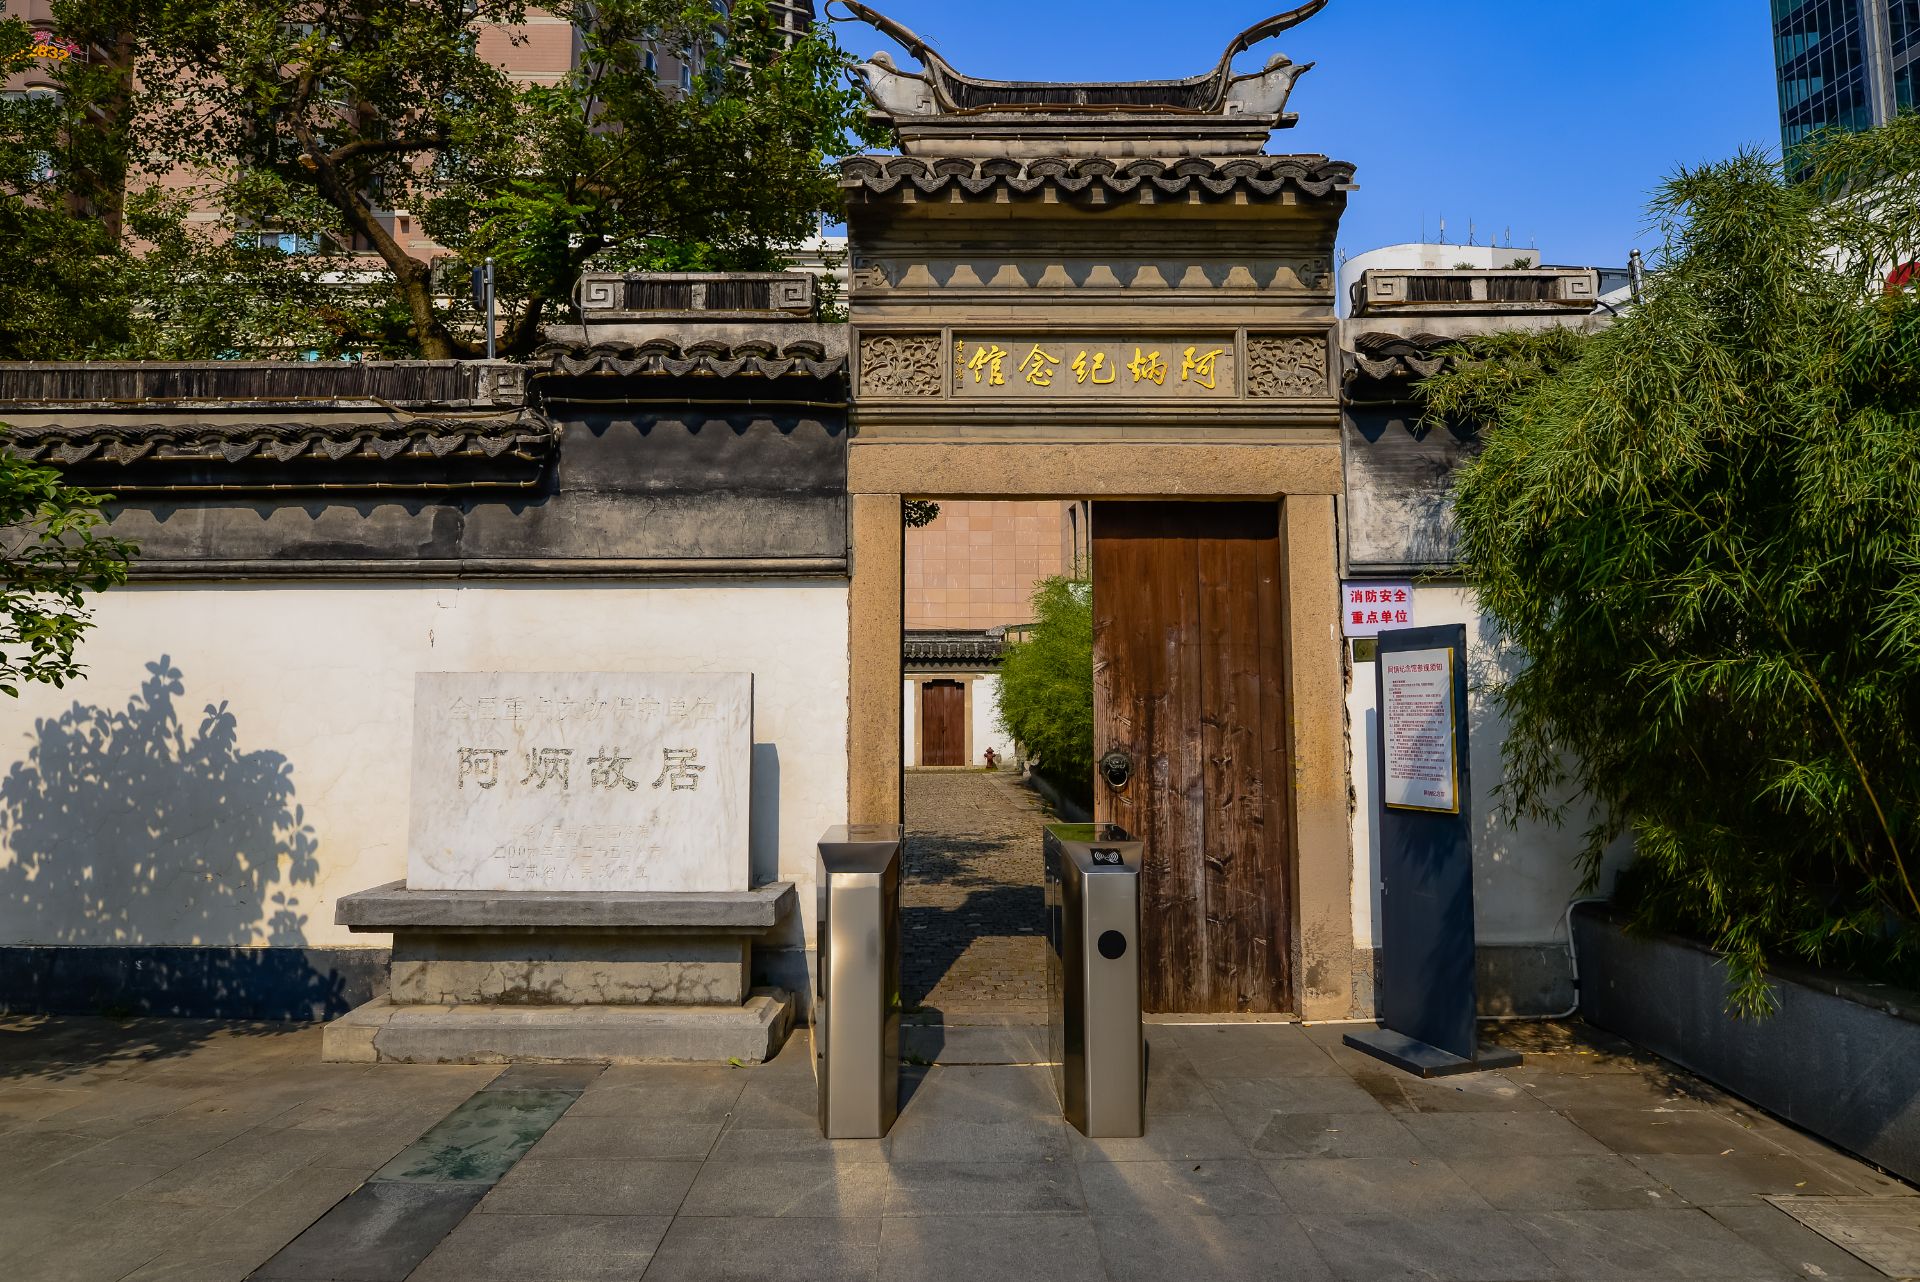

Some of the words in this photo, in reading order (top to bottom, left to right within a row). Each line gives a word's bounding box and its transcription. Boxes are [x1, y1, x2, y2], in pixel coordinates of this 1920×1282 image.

[967, 343, 1224, 391] 阿炳纪念馆
[1350, 589, 1407, 603] 消防安全
[1350, 609, 1408, 625] 重点单位
[456, 744, 707, 792] 阿炳故居
